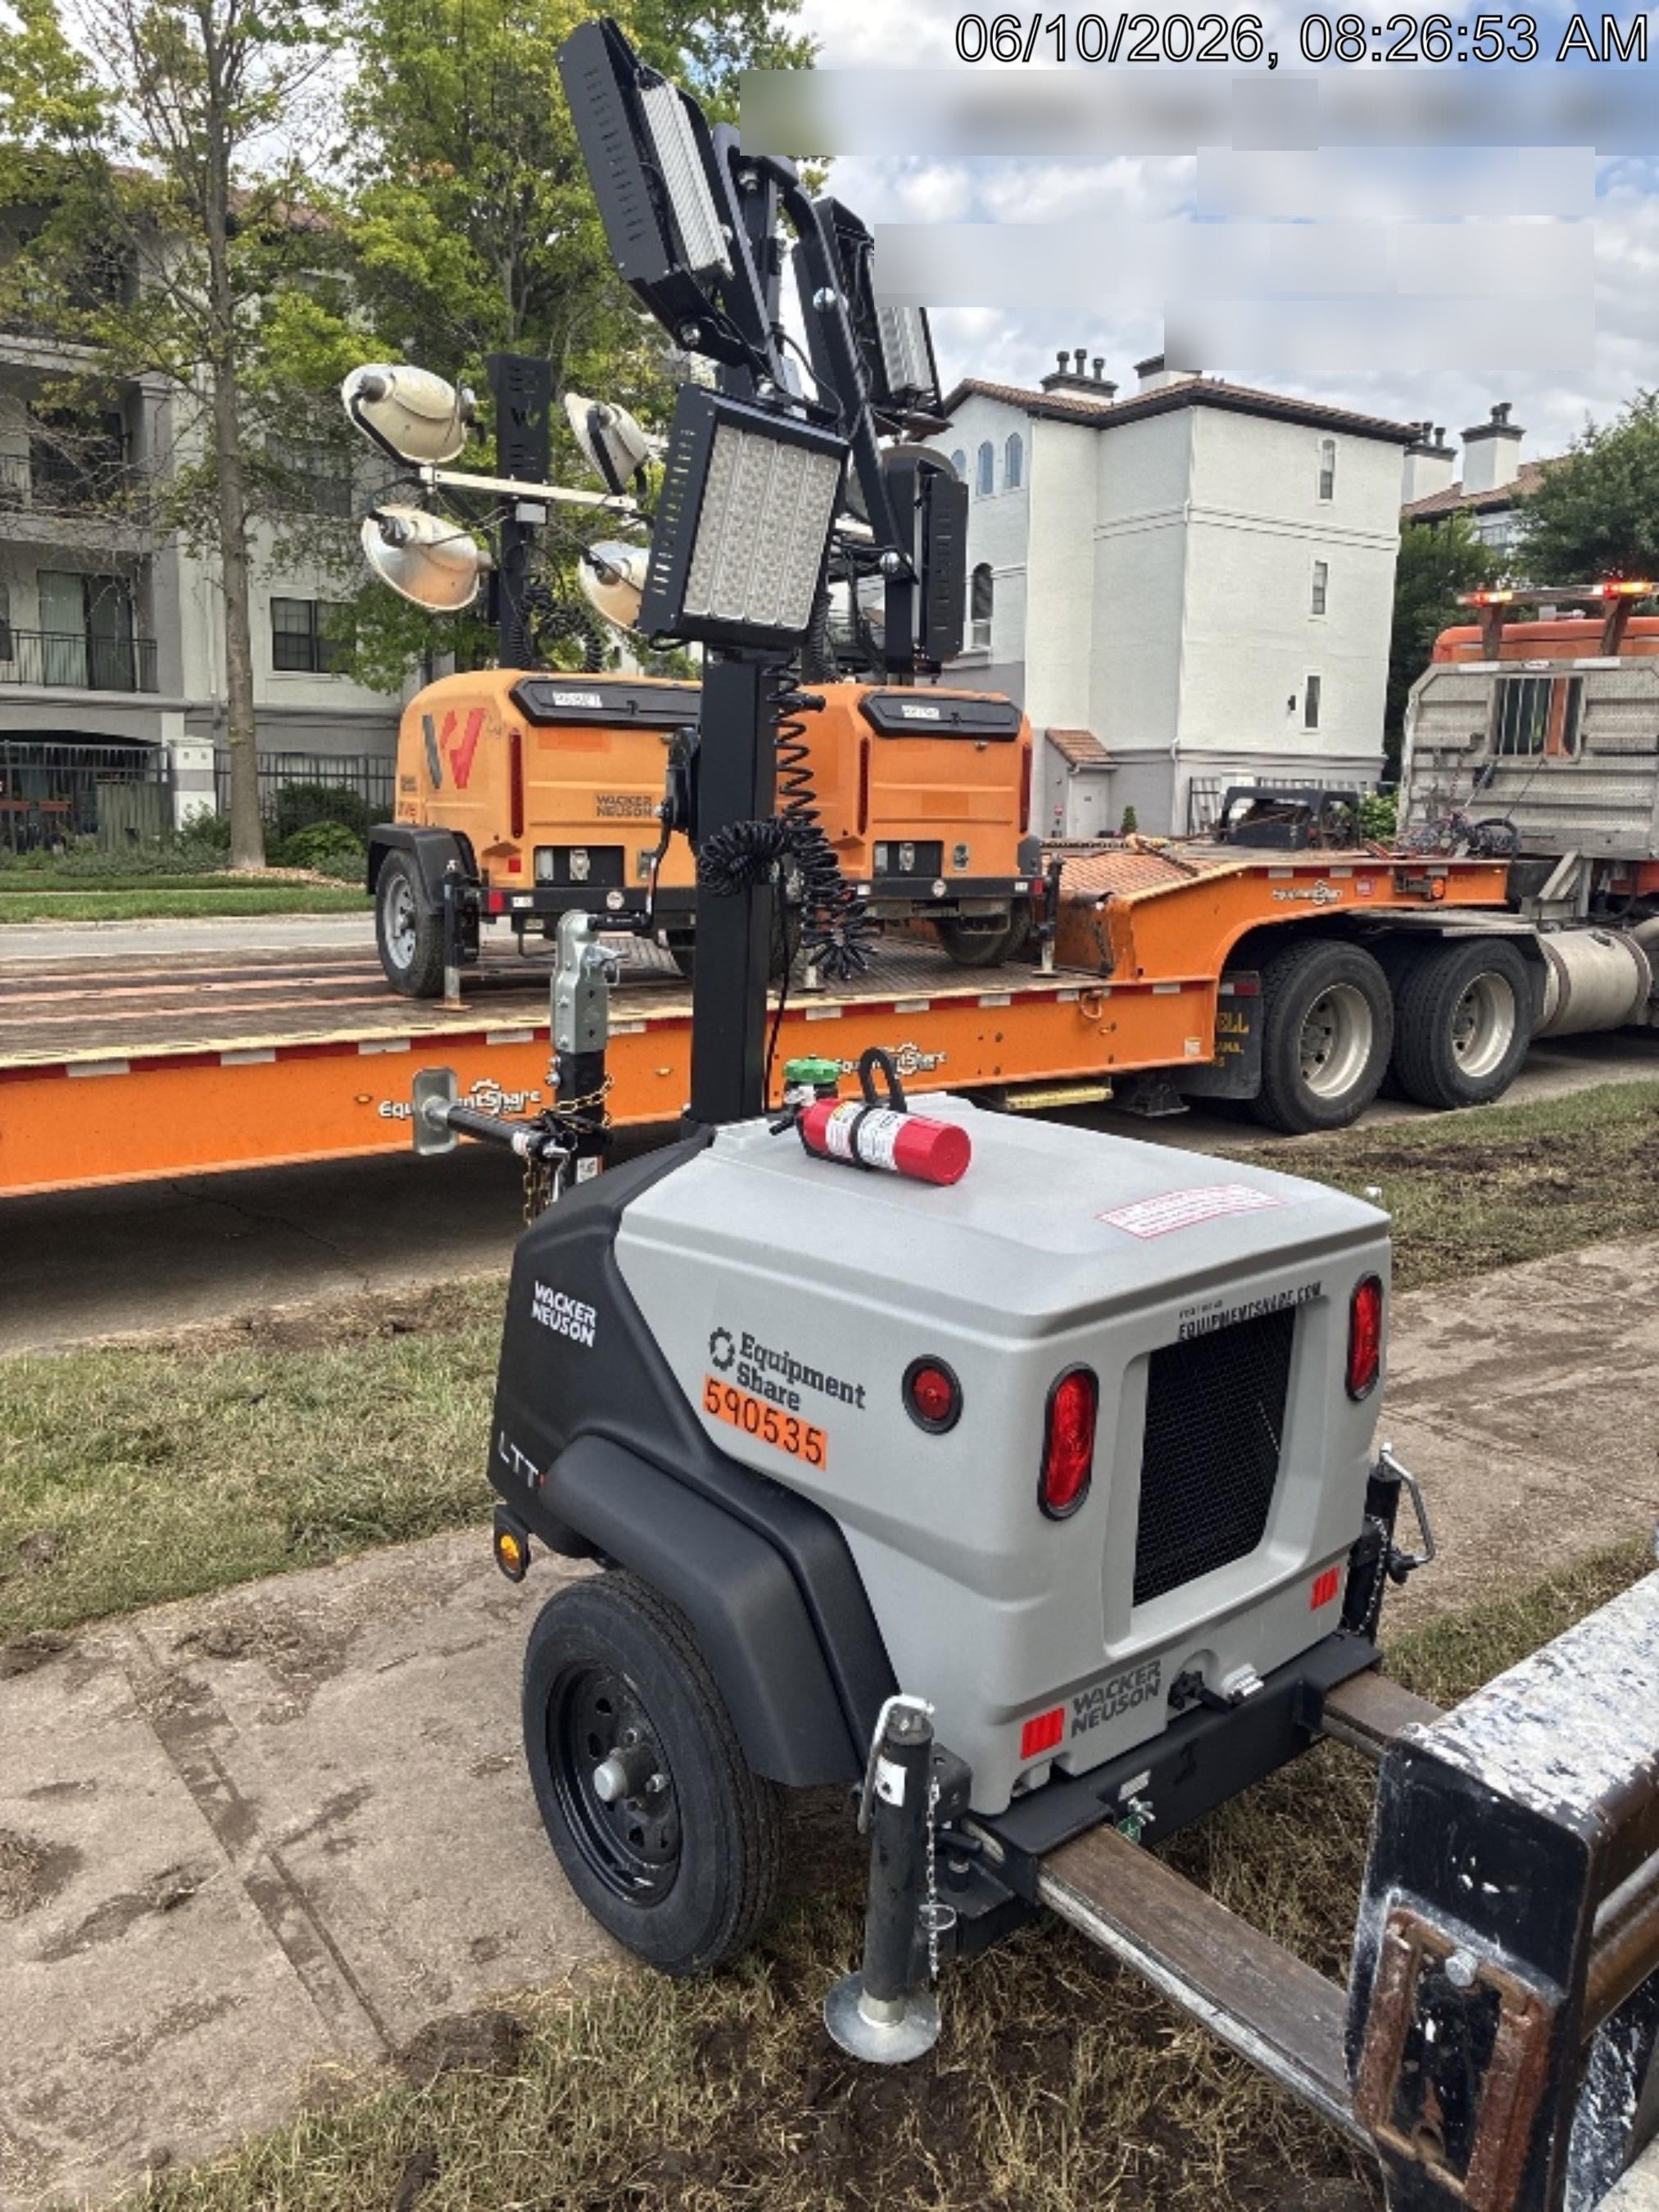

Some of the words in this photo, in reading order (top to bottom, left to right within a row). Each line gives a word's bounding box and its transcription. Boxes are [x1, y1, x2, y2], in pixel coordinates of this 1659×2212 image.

[596, 796, 652, 806] WACKER
[596, 805, 652, 818] NEUSON
[532, 1299, 596, 1349] NEUSON
[534, 1279, 597, 1328] WACKER
[737, 1362, 801, 1412] Share
[739, 1331, 866, 1409] Equipment
[705, 1378, 823, 1465] 590535
[1071, 1679, 1160, 1738] NEUSON
[1072, 1659, 1161, 1716] WACKER
